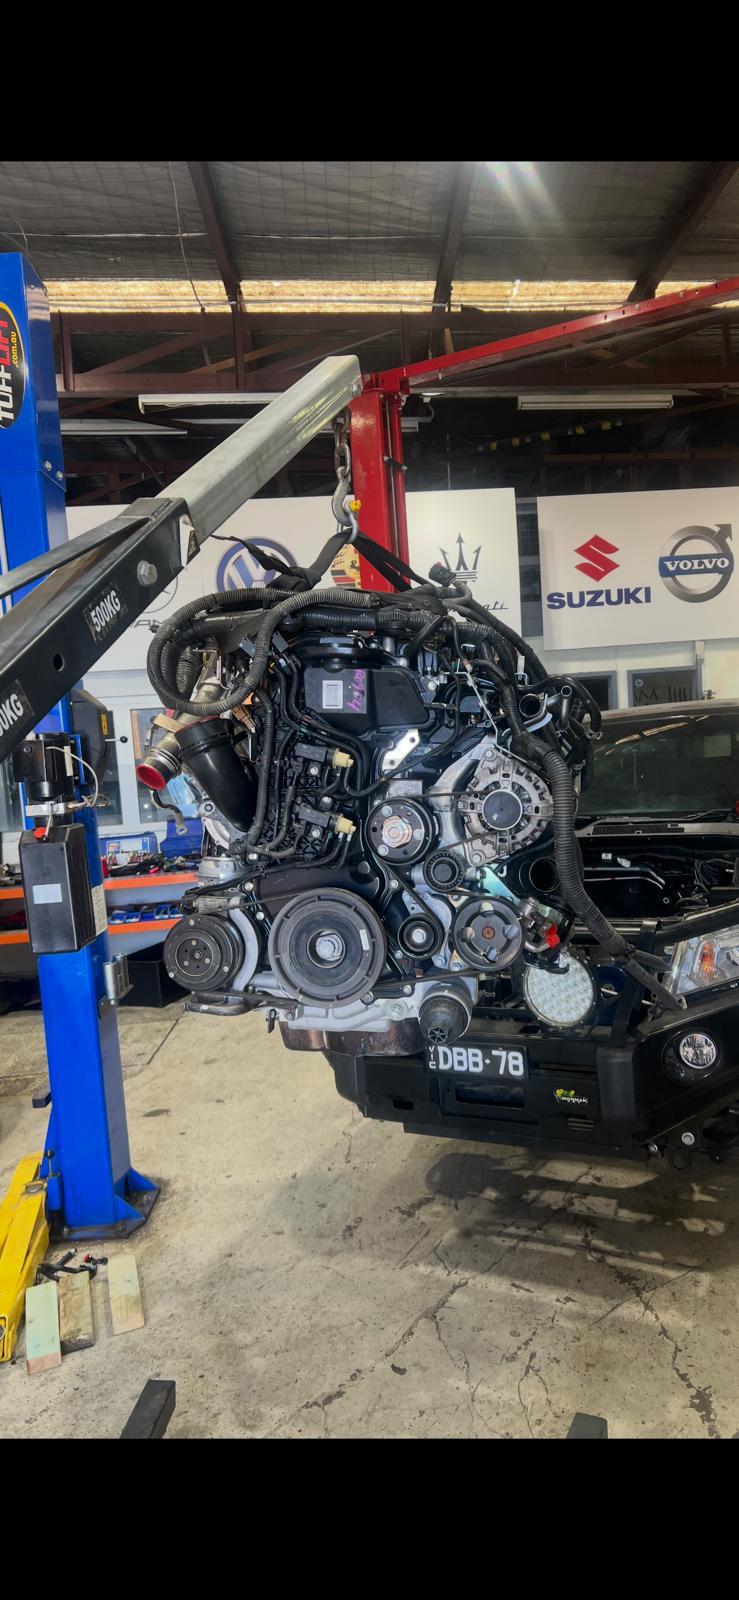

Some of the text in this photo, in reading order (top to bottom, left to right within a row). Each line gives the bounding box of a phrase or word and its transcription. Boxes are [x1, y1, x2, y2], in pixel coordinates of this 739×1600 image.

[664, 557, 729, 571] VOLVO
[546, 586, 651, 609] SUZUKI
[91, 590, 120, 632] 500KG
